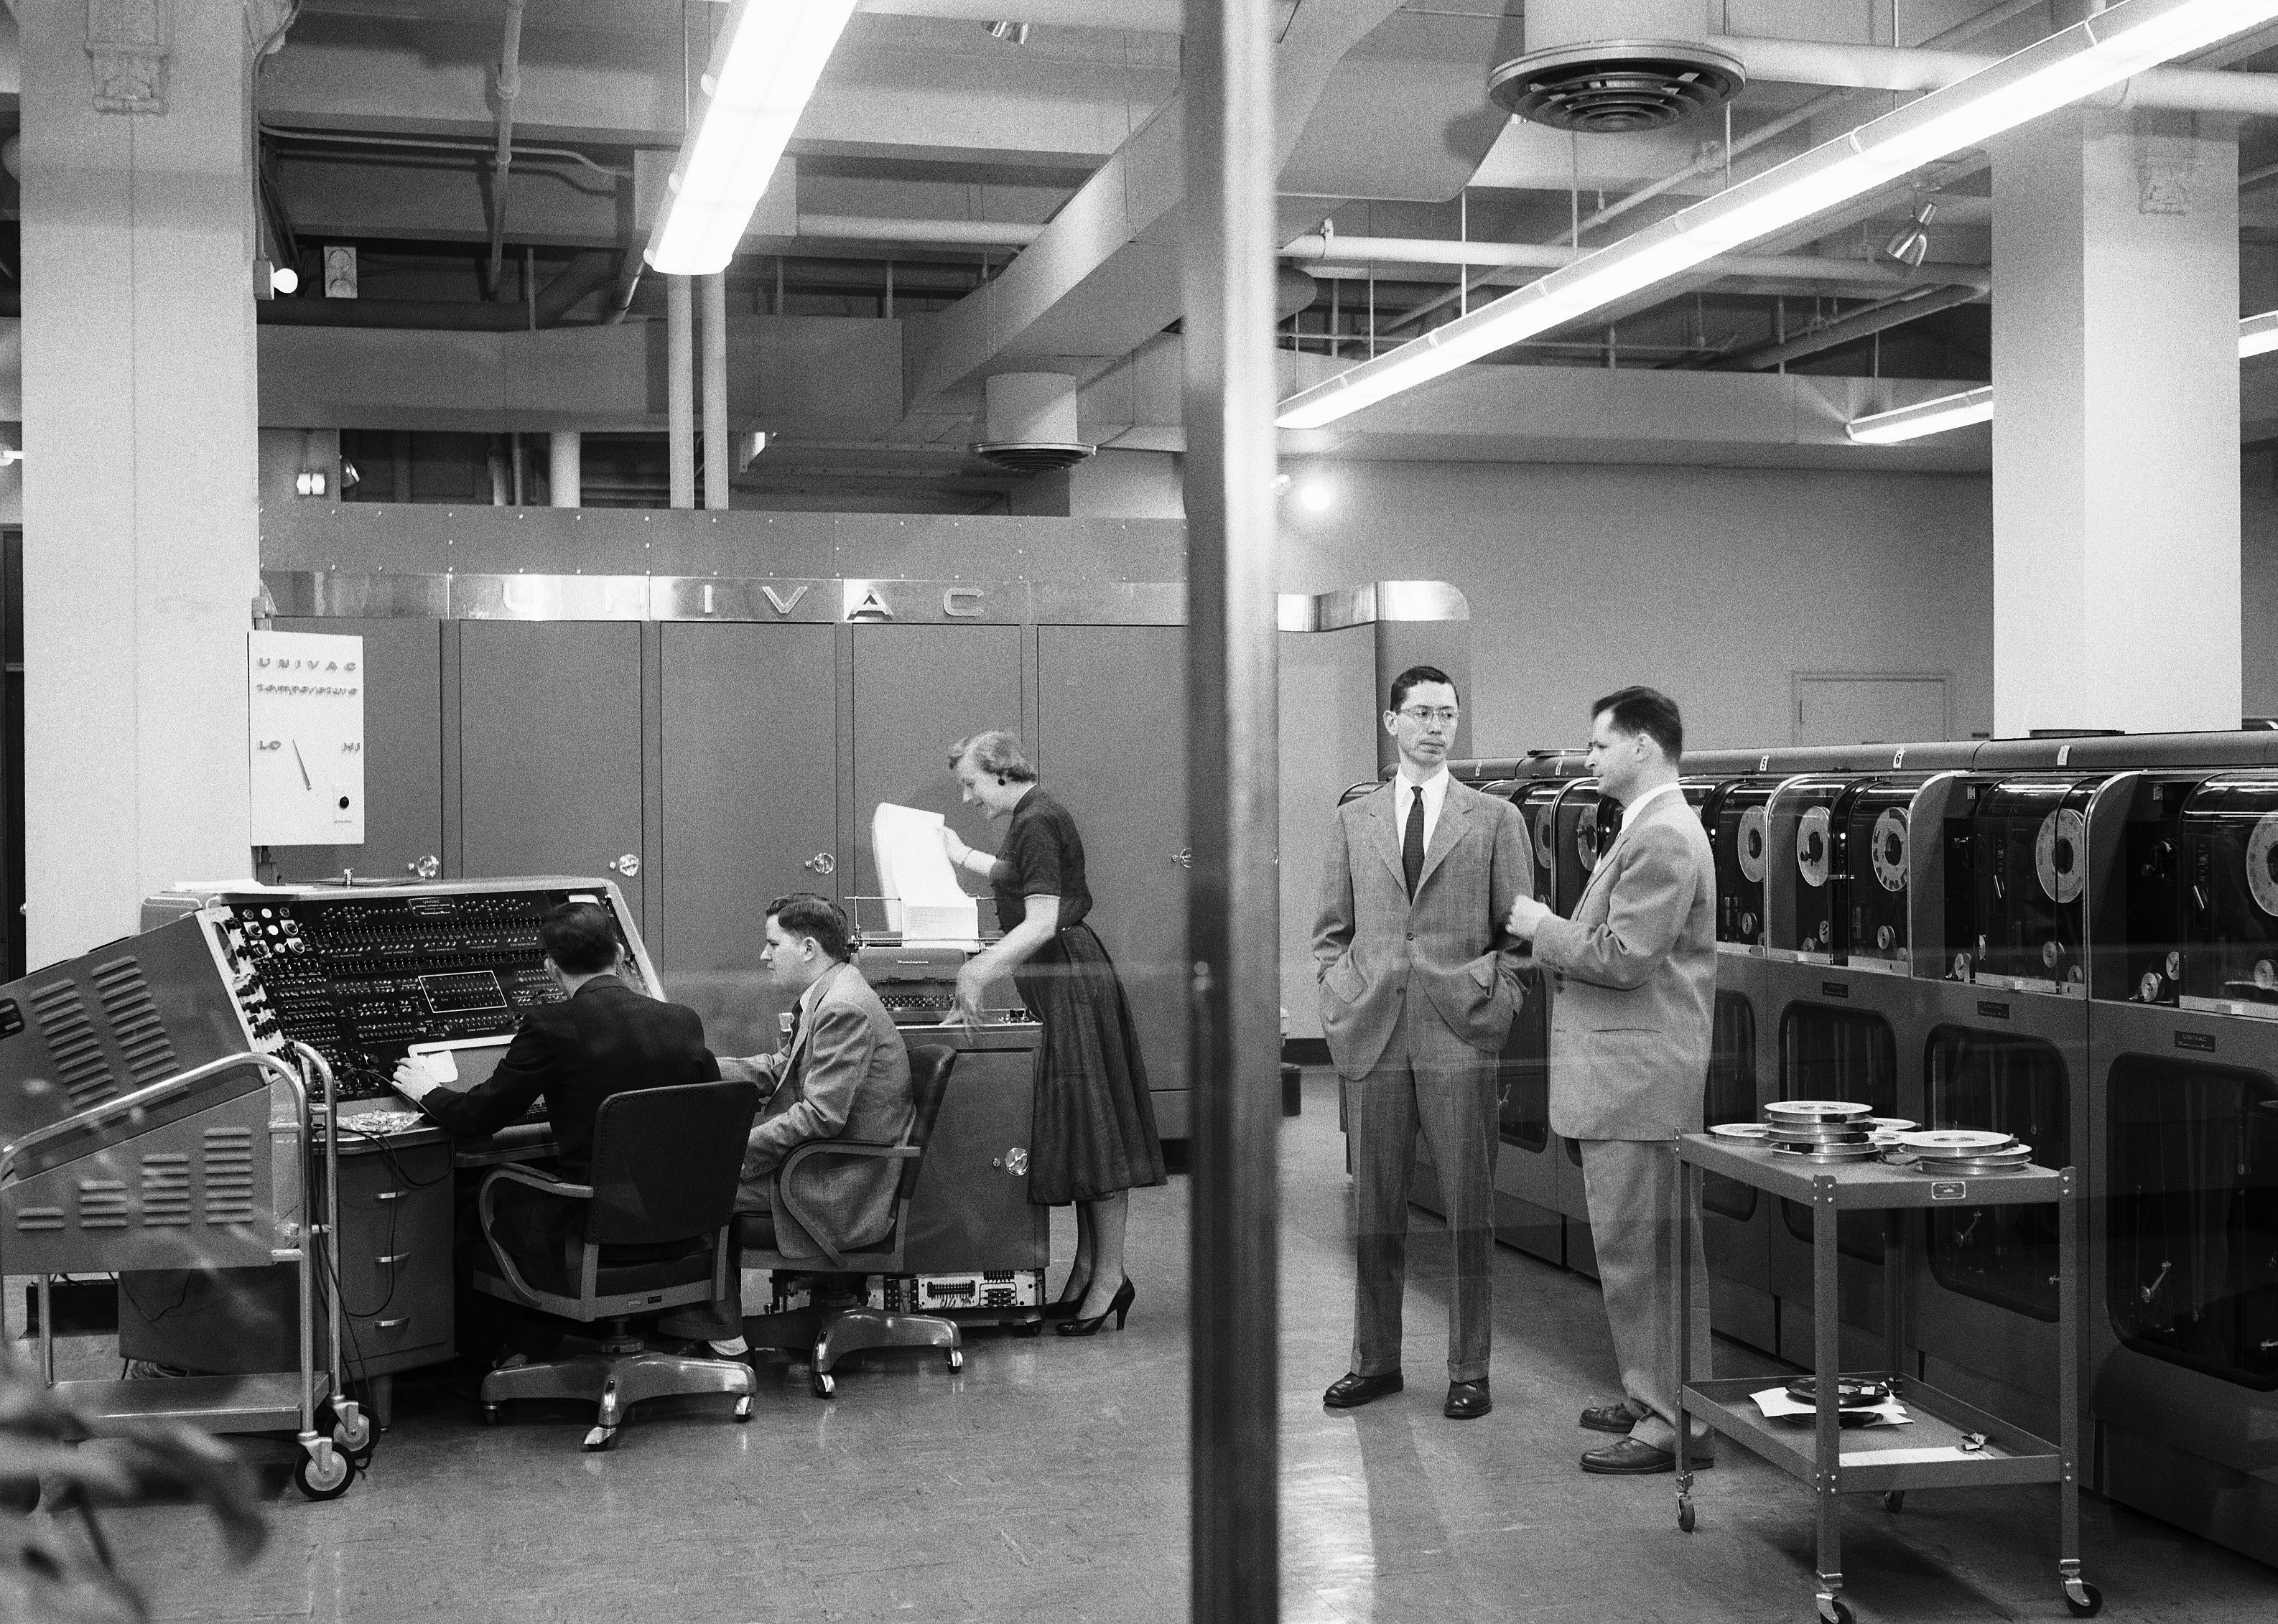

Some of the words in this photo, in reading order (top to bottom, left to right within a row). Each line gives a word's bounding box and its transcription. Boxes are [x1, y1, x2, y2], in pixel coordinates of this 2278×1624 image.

[502, 580, 985, 621] UNIVAC
[258, 658, 356, 672] UNIVAC
[258, 739, 282, 751] LO
[341, 742, 361, 752] HI
[1762, 758, 1767, 769] 5
[1896, 753, 1902, 765] 6
